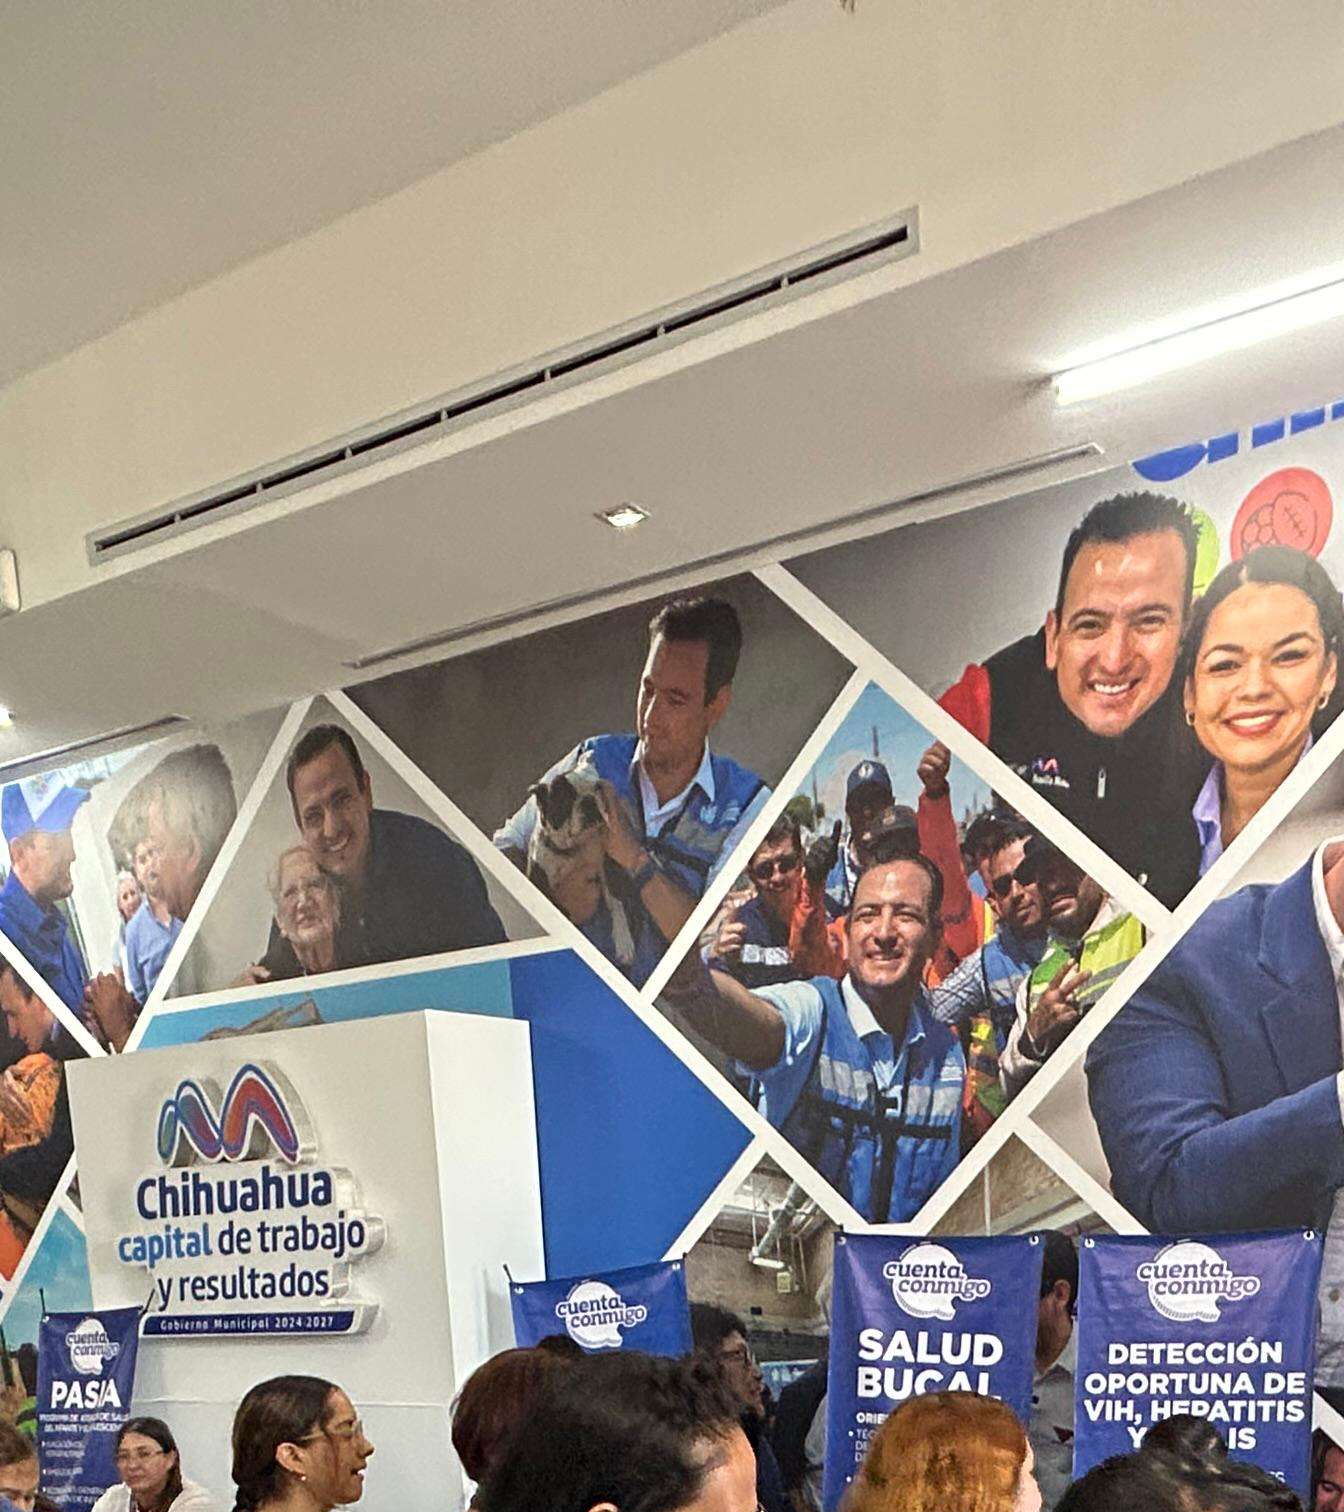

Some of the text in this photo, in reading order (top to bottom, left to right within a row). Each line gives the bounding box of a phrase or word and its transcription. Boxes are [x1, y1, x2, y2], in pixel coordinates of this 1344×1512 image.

[137, 1166, 332, 1219] Chihuahua
[118, 1210, 365, 1268] capital de trabajo
[885, 1260, 963, 1278] cuenta
[1139, 1261, 1225, 1280] cuenta
[157, 1263, 329, 1311] y resultados
[898, 1278, 988, 1299] conmigo
[1155, 1277, 1258, 1298] conmigo
[557, 1295, 621, 1316] cuenta
[160, 1320, 209, 1330] Gobierno
[214, 1317, 269, 1330] Municipal
[571, 1308, 645, 1328] conmigo
[67, 1332, 107, 1345] cuenta
[858, 1328, 1003, 1366] SALUD
[1108, 1336, 1283, 1365] DETECCIÓN
[51, 1378, 122, 1409] PASIA
[857, 1366, 1002, 1400] BUCAL
[1084, 1372, 1306, 1395] OPORTUNA DE
[856, 1412, 890, 1426] ORIE
[1083, 1399, 1305, 1426] VIH, HEPATITIS
[1127, 1426, 1148, 1449] Y
